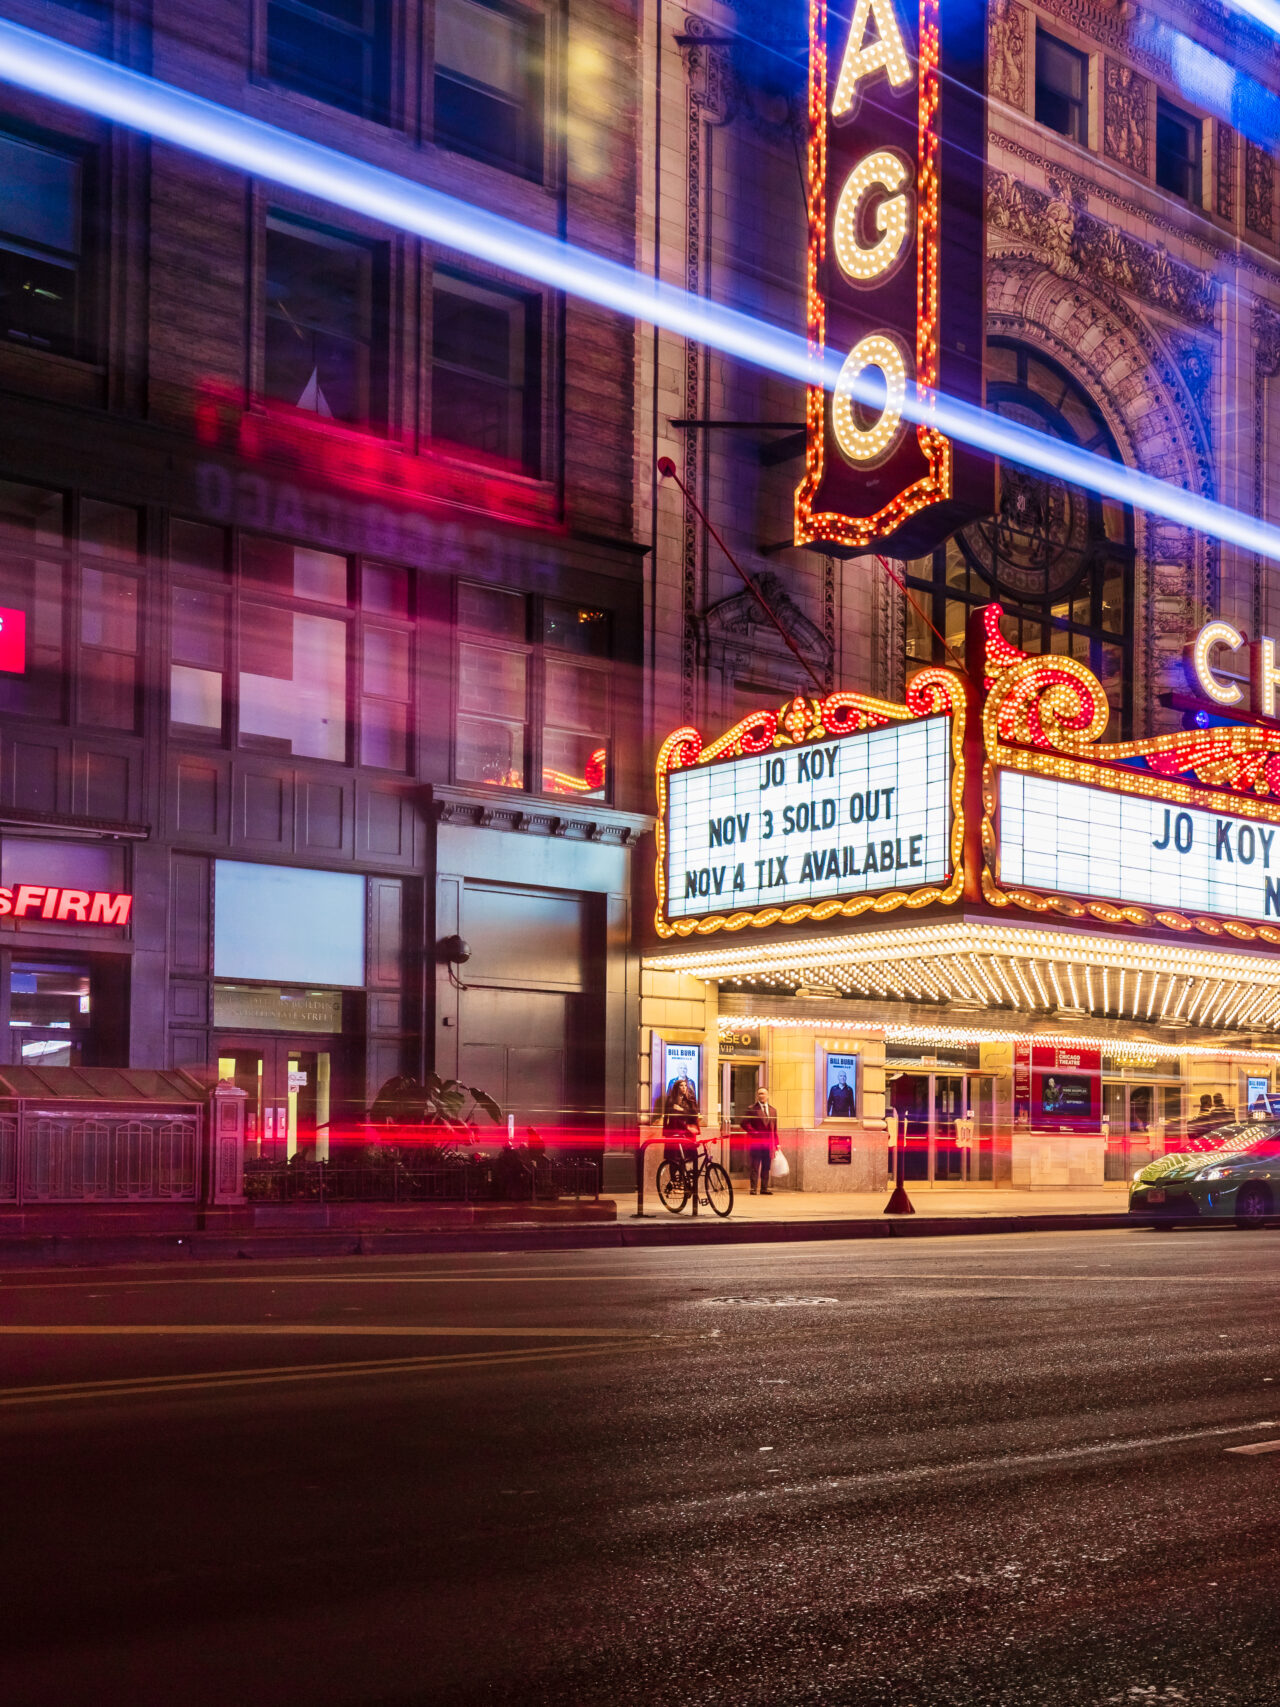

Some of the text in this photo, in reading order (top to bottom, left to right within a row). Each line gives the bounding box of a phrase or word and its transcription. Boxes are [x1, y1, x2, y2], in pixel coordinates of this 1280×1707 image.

[759, 745, 839, 790] JO KOY
[708, 788, 895, 848] NOV 3 SOLD OUT
[1152, 808, 1194, 854] JO
[1216, 819, 1275, 869] KOY
[685, 834, 923, 899] NOV 4 TIX AVAILABLE
[668, 1048, 696, 1057] BILL BURR
[720, 1045, 734, 1053] VIP
[830, 1057, 854, 1066] BILL BURR
